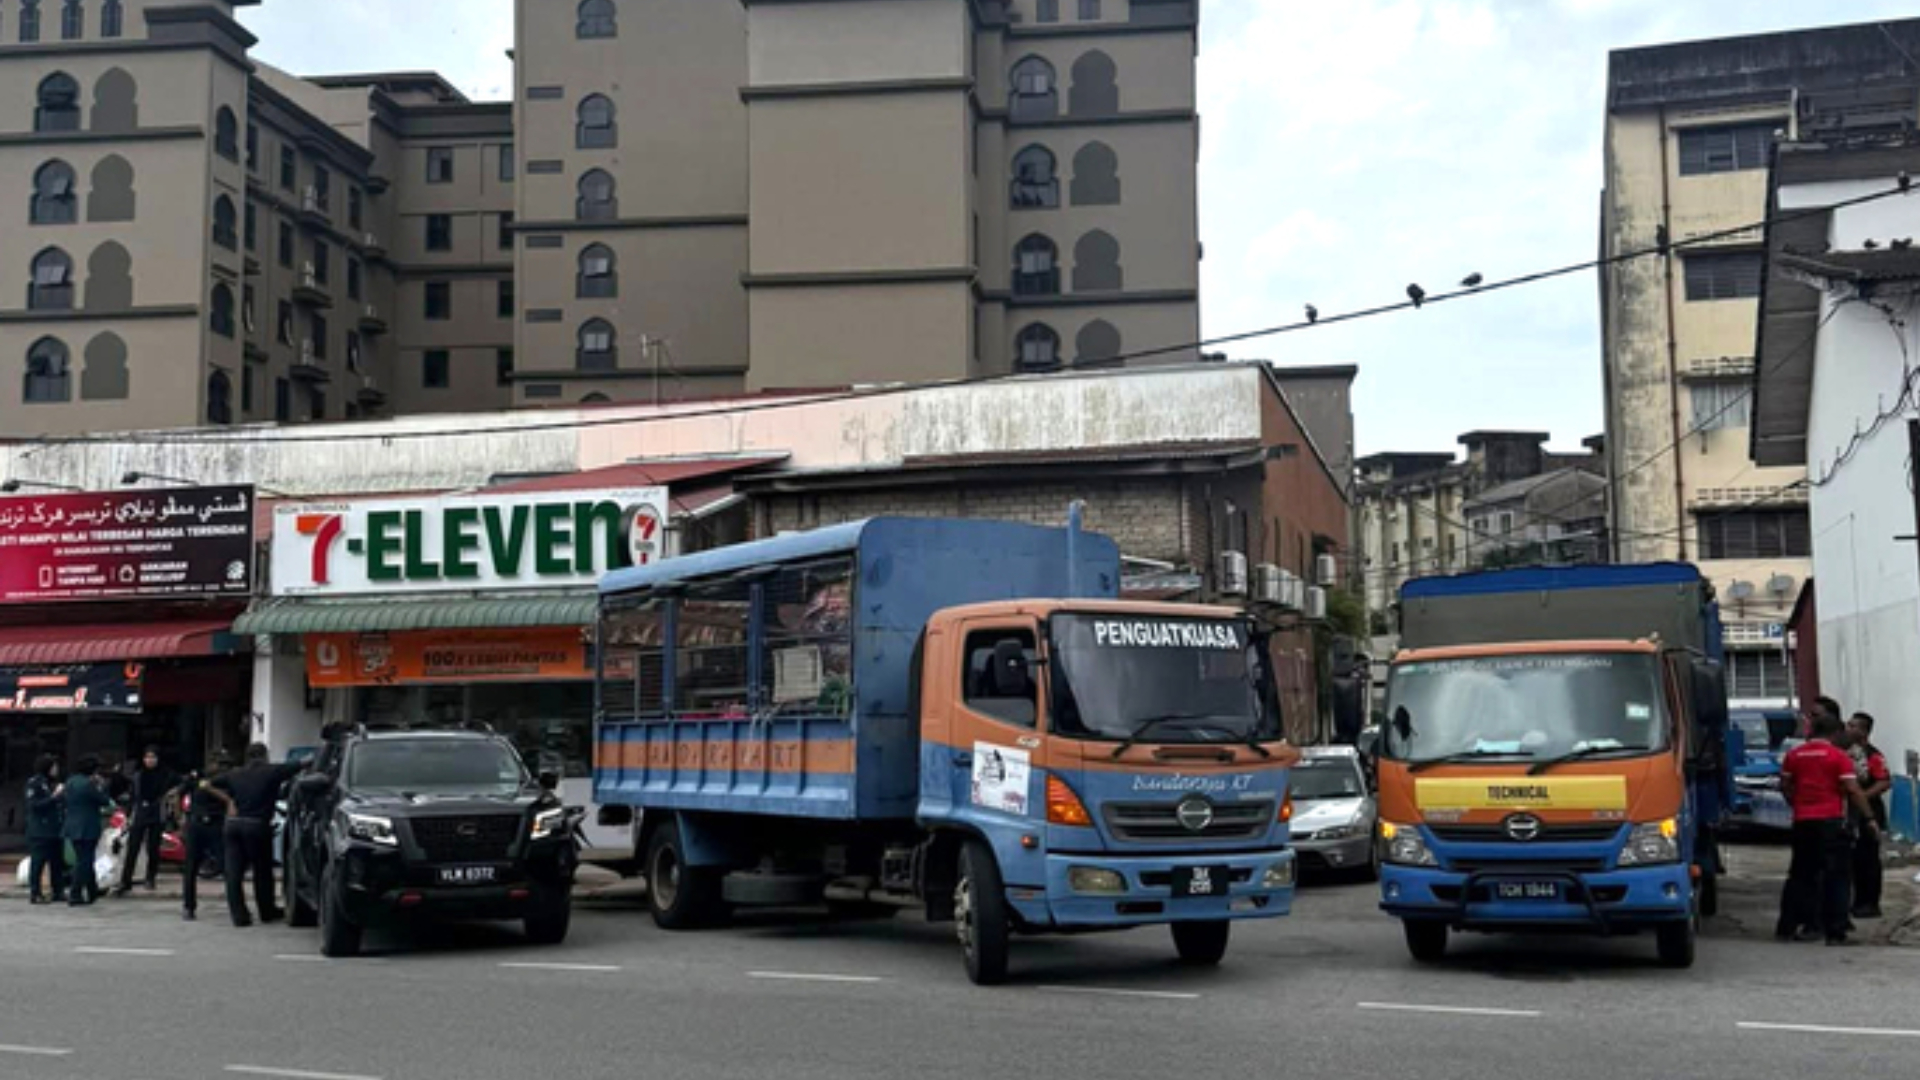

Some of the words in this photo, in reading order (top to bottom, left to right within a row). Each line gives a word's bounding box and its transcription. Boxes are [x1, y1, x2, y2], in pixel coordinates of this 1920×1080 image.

[146, 527, 184, 538] HARGA
[186, 524, 247, 537] TERENDAH
[1094, 620, 1240, 649] PENGUATKUASA
[1487, 785, 1550, 800] TECHNICAL
